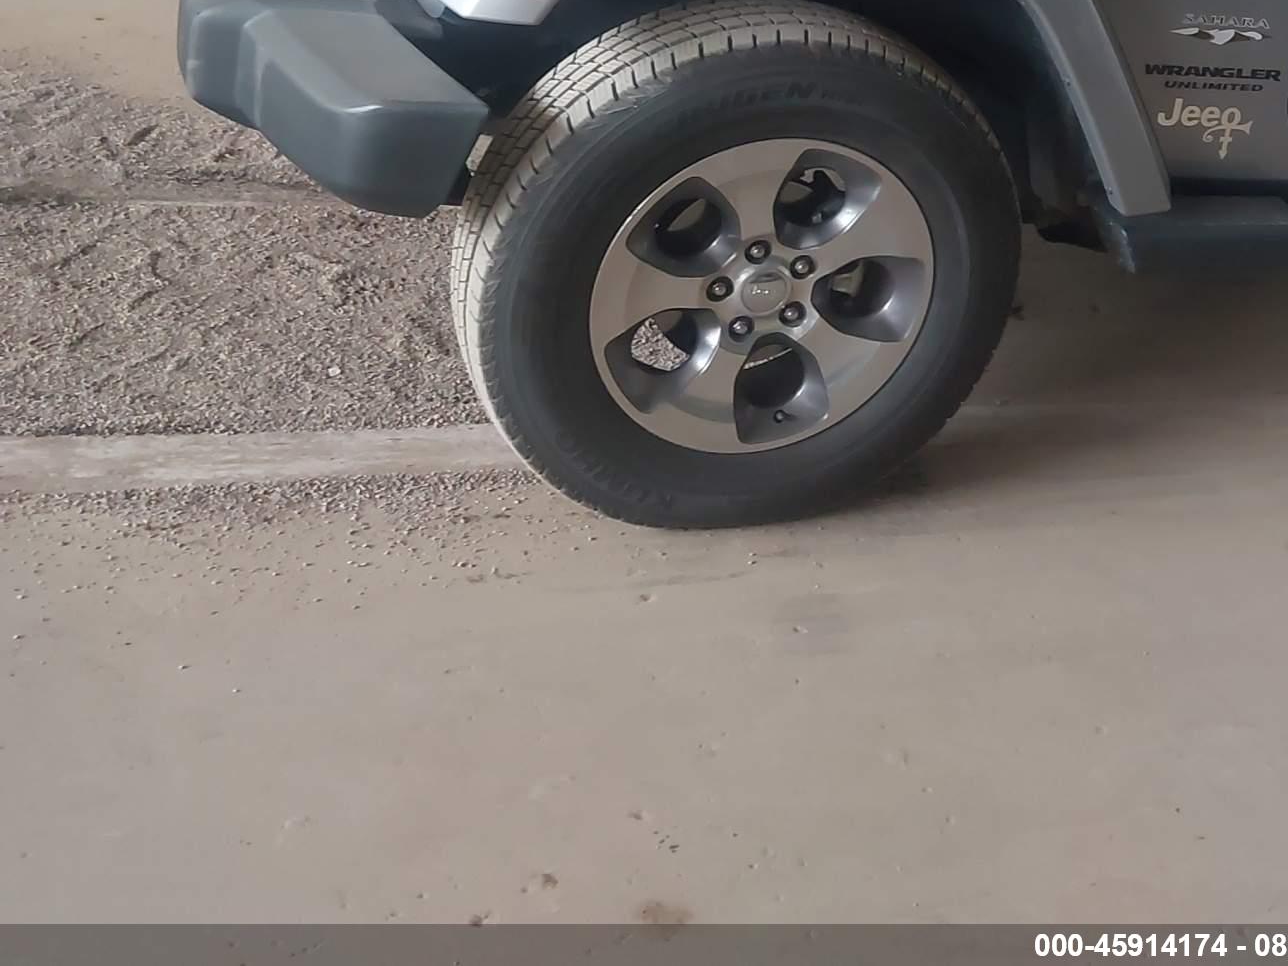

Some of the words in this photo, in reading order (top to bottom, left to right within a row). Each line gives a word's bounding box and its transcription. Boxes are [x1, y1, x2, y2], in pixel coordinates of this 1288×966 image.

[1183, 13, 1270, 29] SAHARA
[1145, 63, 1281, 82] WRANGLER
[1164, 80, 1263, 93] UNLIMITED
